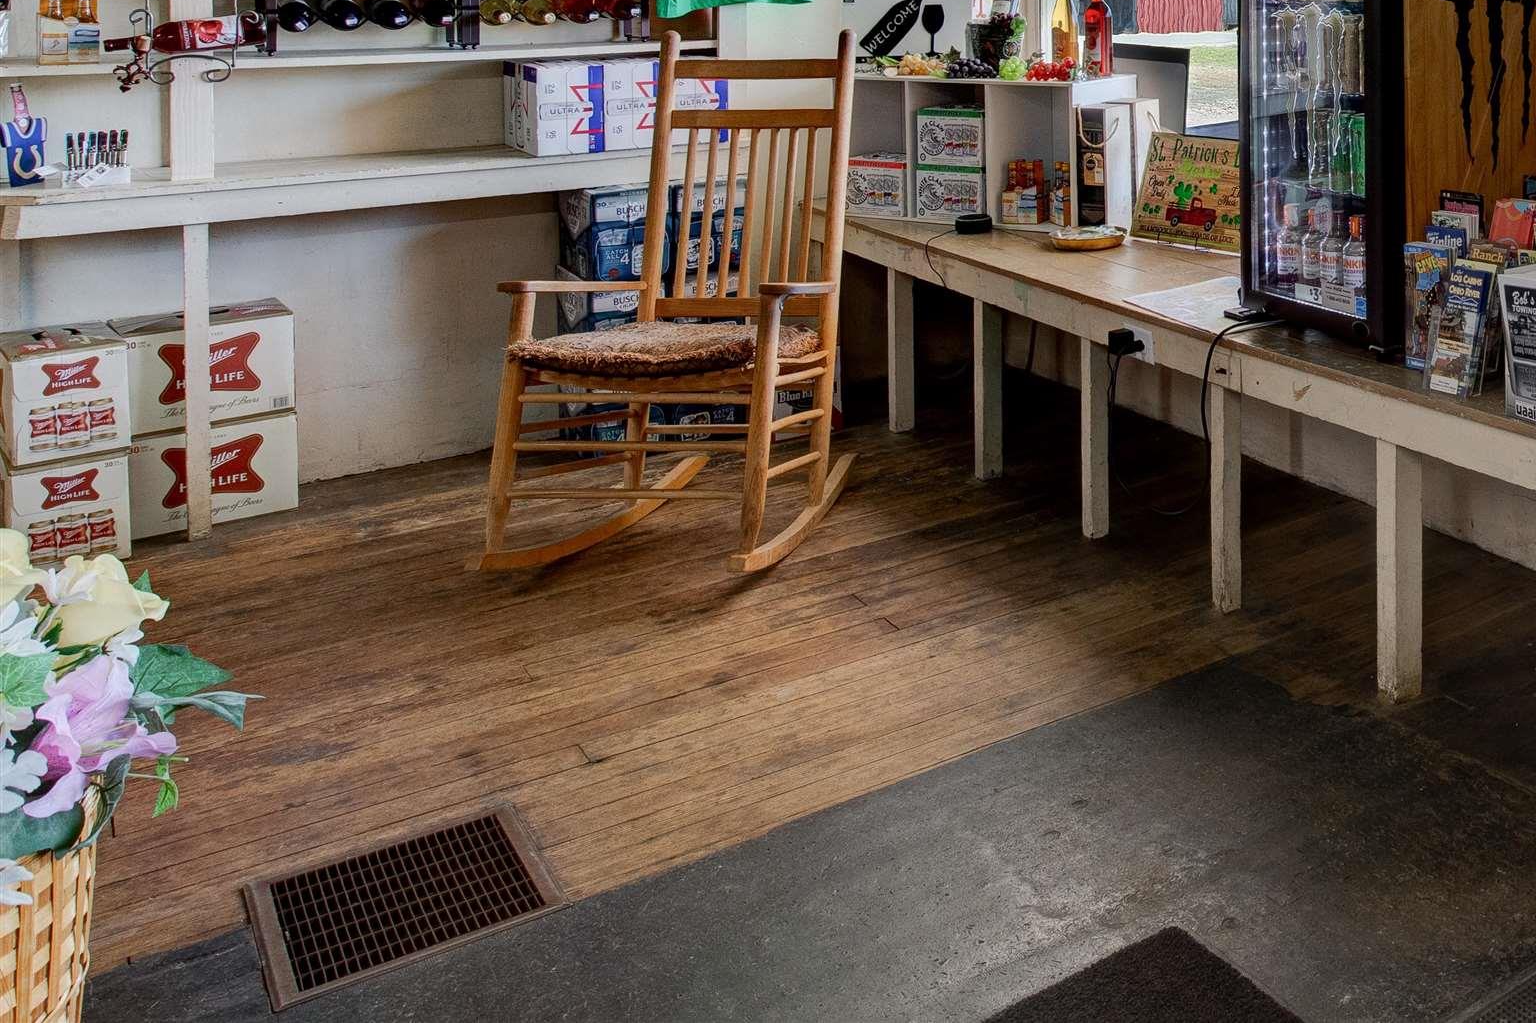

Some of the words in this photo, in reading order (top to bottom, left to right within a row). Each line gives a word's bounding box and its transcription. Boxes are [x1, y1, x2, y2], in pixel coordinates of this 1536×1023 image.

[864, 0, 920, 53] WELCOME
[616, 102, 646, 111] ULTRA
[679, 98, 708, 107] ULTRA
[549, 106, 581, 115] ULTRA
[697, 196, 725, 208] BSCH
[616, 204, 646, 216] BUSCH
[620, 253, 630, 265] 4
[1472, 248, 1504, 263] Ranch
[1512, 291, 1535, 305] Bob's
[54, 363, 89, 381] Miller
[216, 370, 245, 384] LIFE
[51, 379, 75, 389] HIGH
[75, 377, 92, 385] LIFE
[211, 449, 241, 469] iller
[53, 477, 87, 494] Miller
[218, 472, 248, 486] LIFE
[50, 491, 73, 502] HIGH
[73, 488, 91, 498] LIFE
[239, 497, 263, 509] Beers
